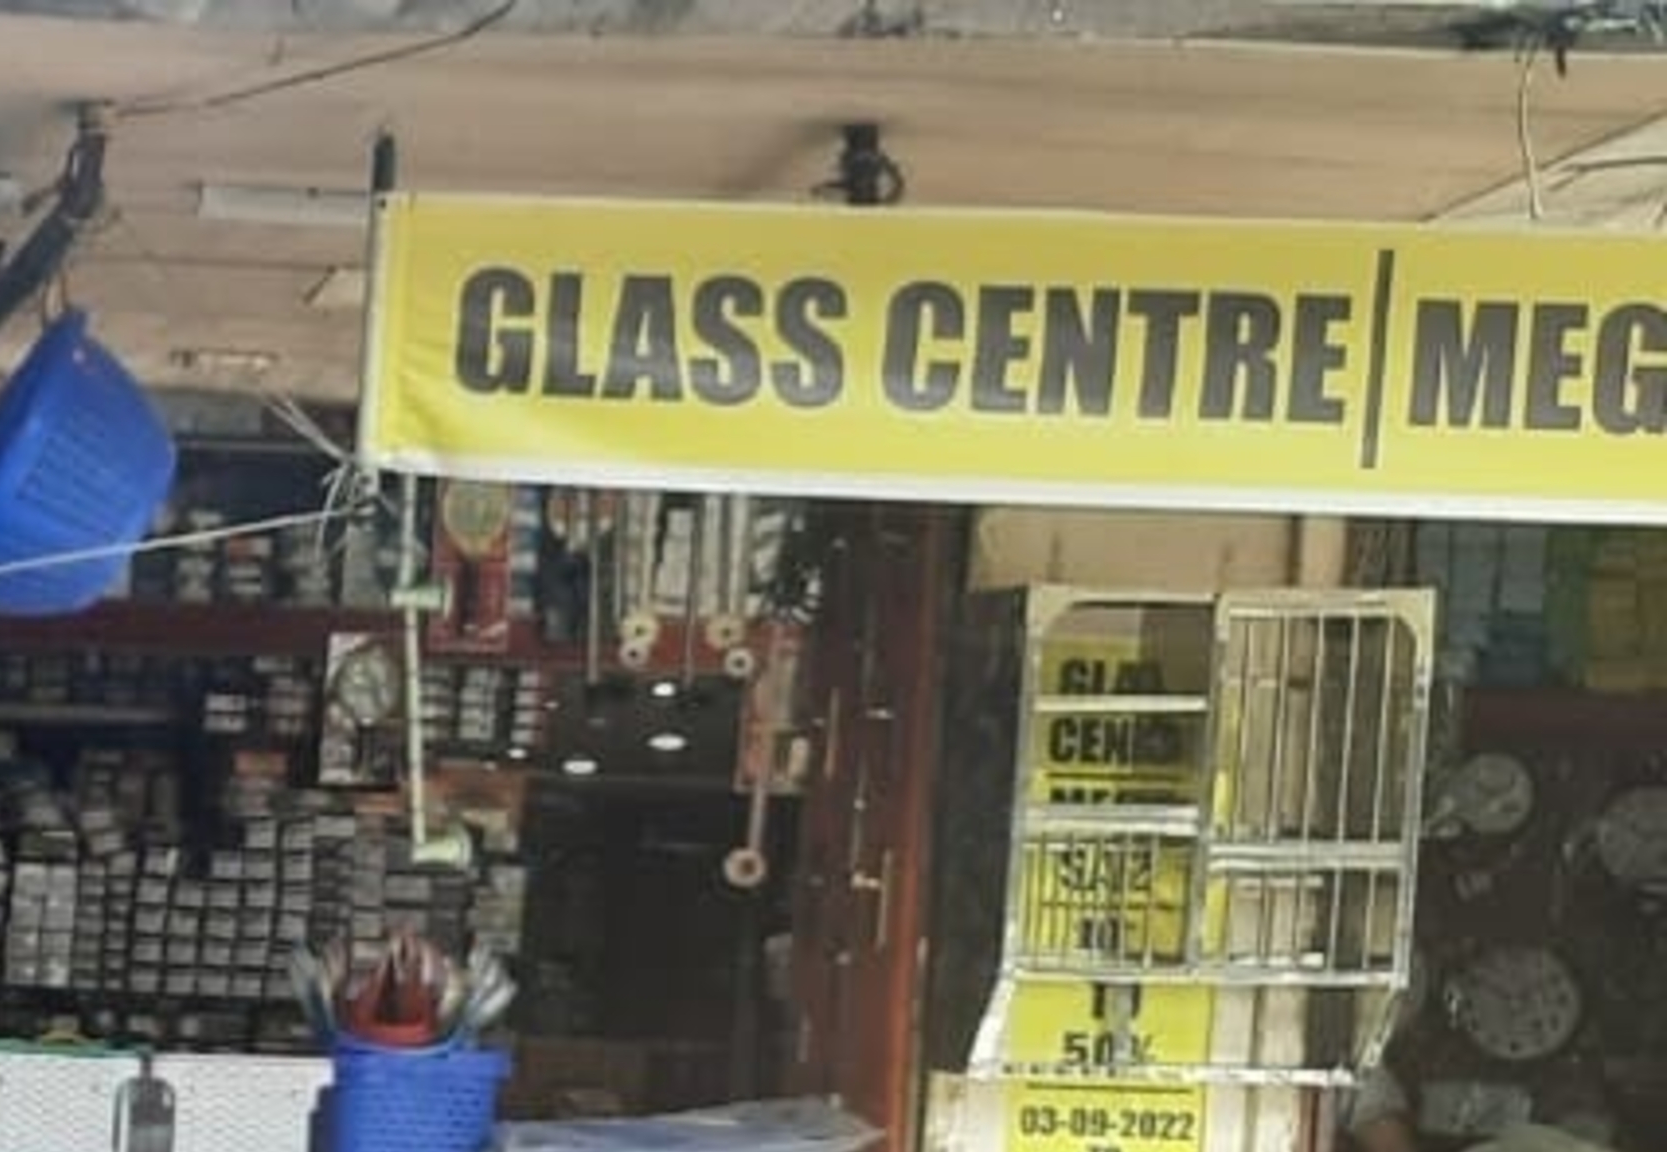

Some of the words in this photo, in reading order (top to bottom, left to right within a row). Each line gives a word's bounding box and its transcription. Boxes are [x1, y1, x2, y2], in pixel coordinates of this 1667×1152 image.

[455, 266, 848, 409] GLASS
[881, 280, 1352, 424] CENTRE
[1407, 299, 1667, 435] MEG
[1019, 1105, 1196, 1142] 03-09-2022
